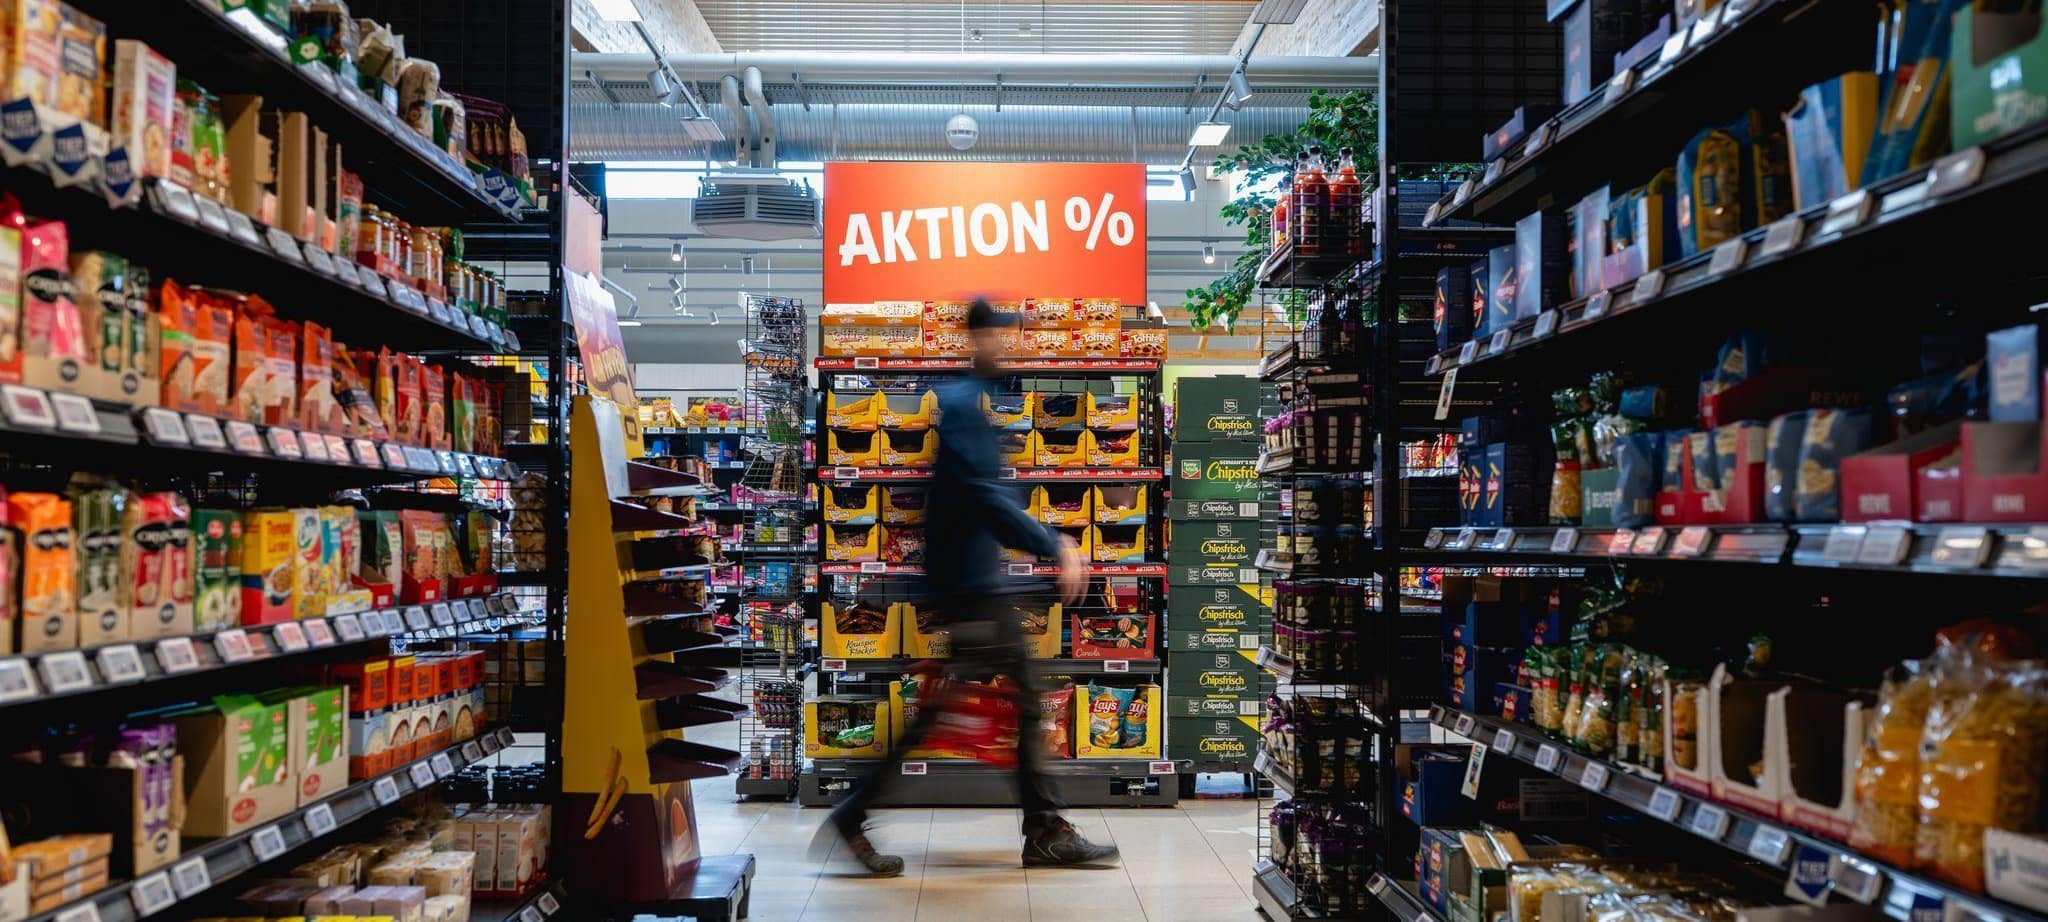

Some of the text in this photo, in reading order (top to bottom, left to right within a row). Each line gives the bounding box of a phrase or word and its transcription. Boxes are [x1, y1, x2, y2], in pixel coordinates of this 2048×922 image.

[838, 192, 1135, 266] AKTION %
[936, 303, 968, 315] Toffifee
[1038, 303, 1071, 313] Toffifee
[1085, 303, 1117, 313] Toffifee
[936, 332, 969, 344] Toffifee
[1035, 332, 1068, 344] Toffifee
[1084, 332, 1116, 344] Toffifee
[1131, 333, 1165, 345] Toffifee
[1207, 416, 1252, 431] Chipsfrisch
[1206, 461, 1259, 481] Chipsfris
[1201, 540, 1246, 554] Chipsfrisch
[1199, 606, 1244, 621] Chipsfrisch
[845, 639, 878, 649] Knusper
[849, 647, 878, 656] Flocken
[1199, 672, 1245, 687] Chipsfrisch
[1092, 699, 1119, 714] Lay's
[820, 719, 849, 732] BUGLES
[1199, 738, 1245, 752] Chipsfrisch
